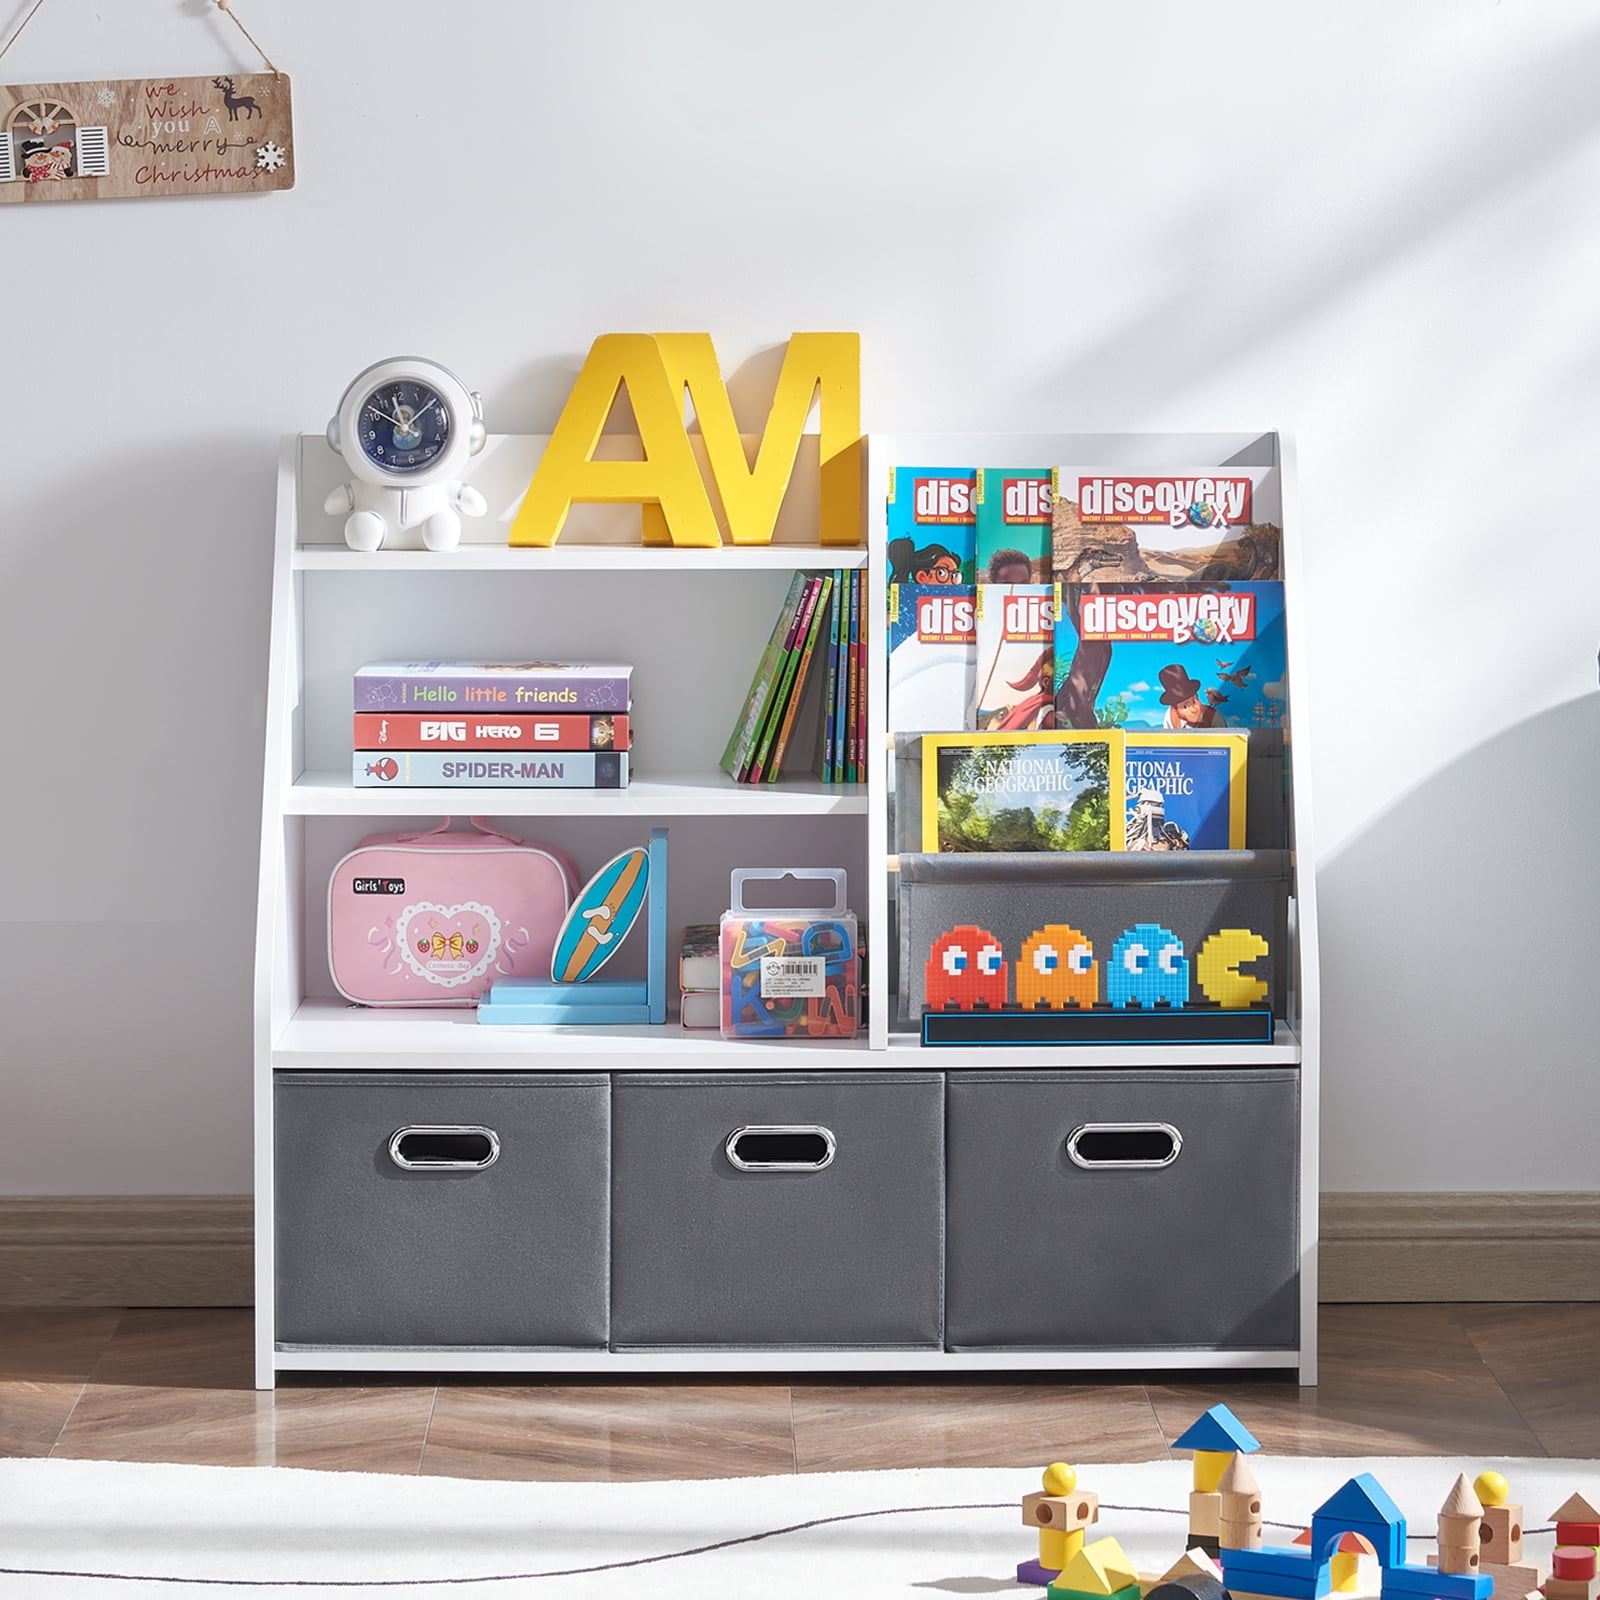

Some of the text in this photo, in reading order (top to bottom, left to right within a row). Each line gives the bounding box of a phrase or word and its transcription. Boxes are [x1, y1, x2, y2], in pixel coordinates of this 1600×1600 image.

[145, 83, 181, 99] we
[146, 101, 210, 120] Wish
[151, 117, 222, 137] you A
[135, 163, 266, 185] Christmas
[369, 431, 376, 440] 9
[377, 445, 384, 454] 8
[408, 455, 415, 463] 6
[1081, 478, 1246, 518] discovery
[1083, 594, 1250, 635] discovery
[413, 685, 578, 703] Hello little friends
[420, 721, 560, 741] BIG HERO 6
[442, 762, 564, 778] SPIDER-MAN
[985, 758, 1064, 777] NATIONAL
[974, 774, 1073, 794] GEOGRAPHIC
